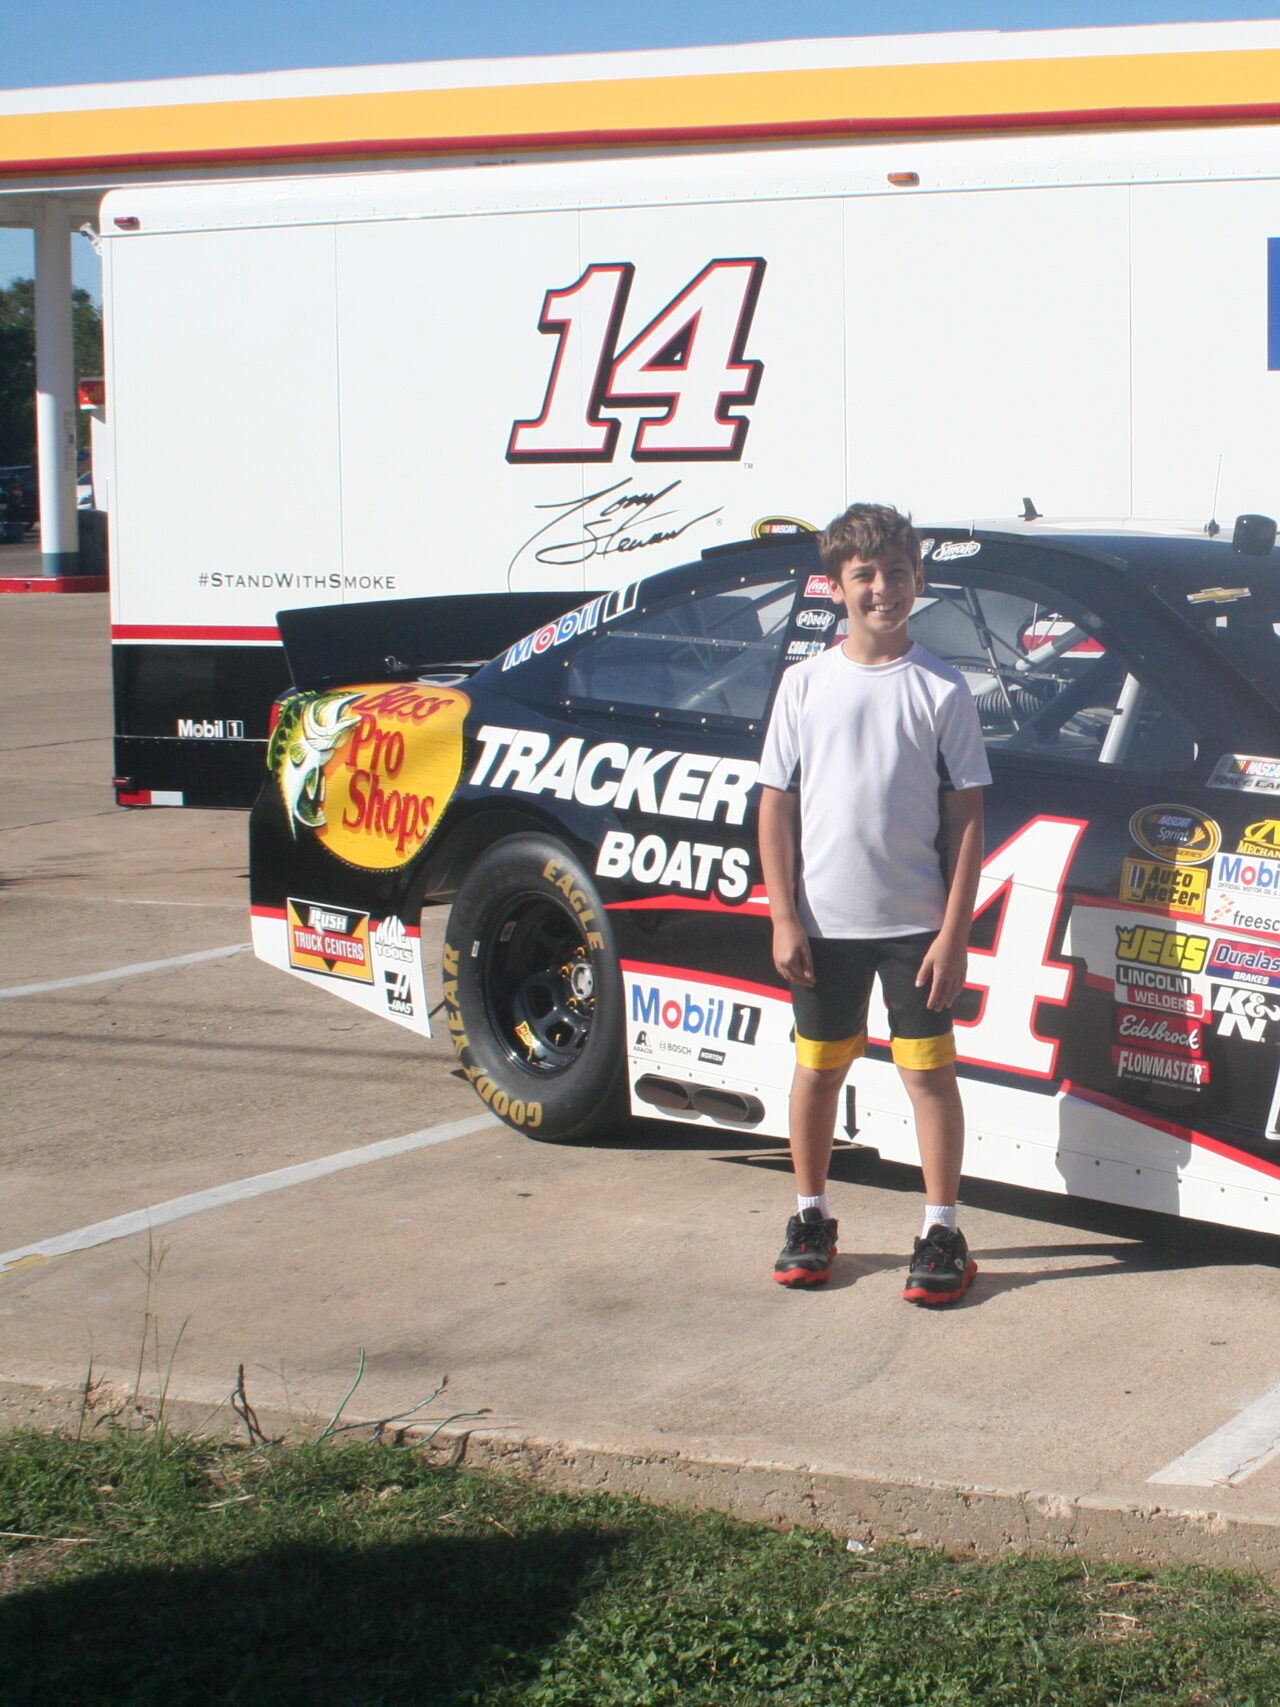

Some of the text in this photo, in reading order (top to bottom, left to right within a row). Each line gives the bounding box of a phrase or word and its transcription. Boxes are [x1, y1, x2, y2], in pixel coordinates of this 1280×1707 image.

[505, 256, 767, 464] 14
[502, 596, 601, 672] Mobil
[352, 686, 454, 719] Bass
[178, 719, 223, 738] Mobil
[345, 713, 405, 773] Pro
[469, 725, 759, 825] TRACKER
[342, 769, 435, 852] Shops
[1157, 826, 1190, 841] Sprint
[595, 831, 750, 899] BOATS
[1147, 867, 1193, 888] Auto
[543, 859, 605, 950] EAGLE
[1143, 881, 1200, 907] Meter
[294, 931, 364, 961] TRUCK CENTERS
[376, 944, 413, 963] TOOLS
[1116, 925, 1210, 974] JEGS
[1119, 967, 1188, 994] LINCOLN
[1233, 971, 1269, 985] BRAKES
[632, 984, 724, 1038] Mobil
[1134, 989, 1195, 1012] WELDERS
[1119, 1015, 1199, 1049] Edelbrock
[668, 1043, 692, 1055] BOSCH
[1117, 1050, 1202, 1084] FLOWMASTER
